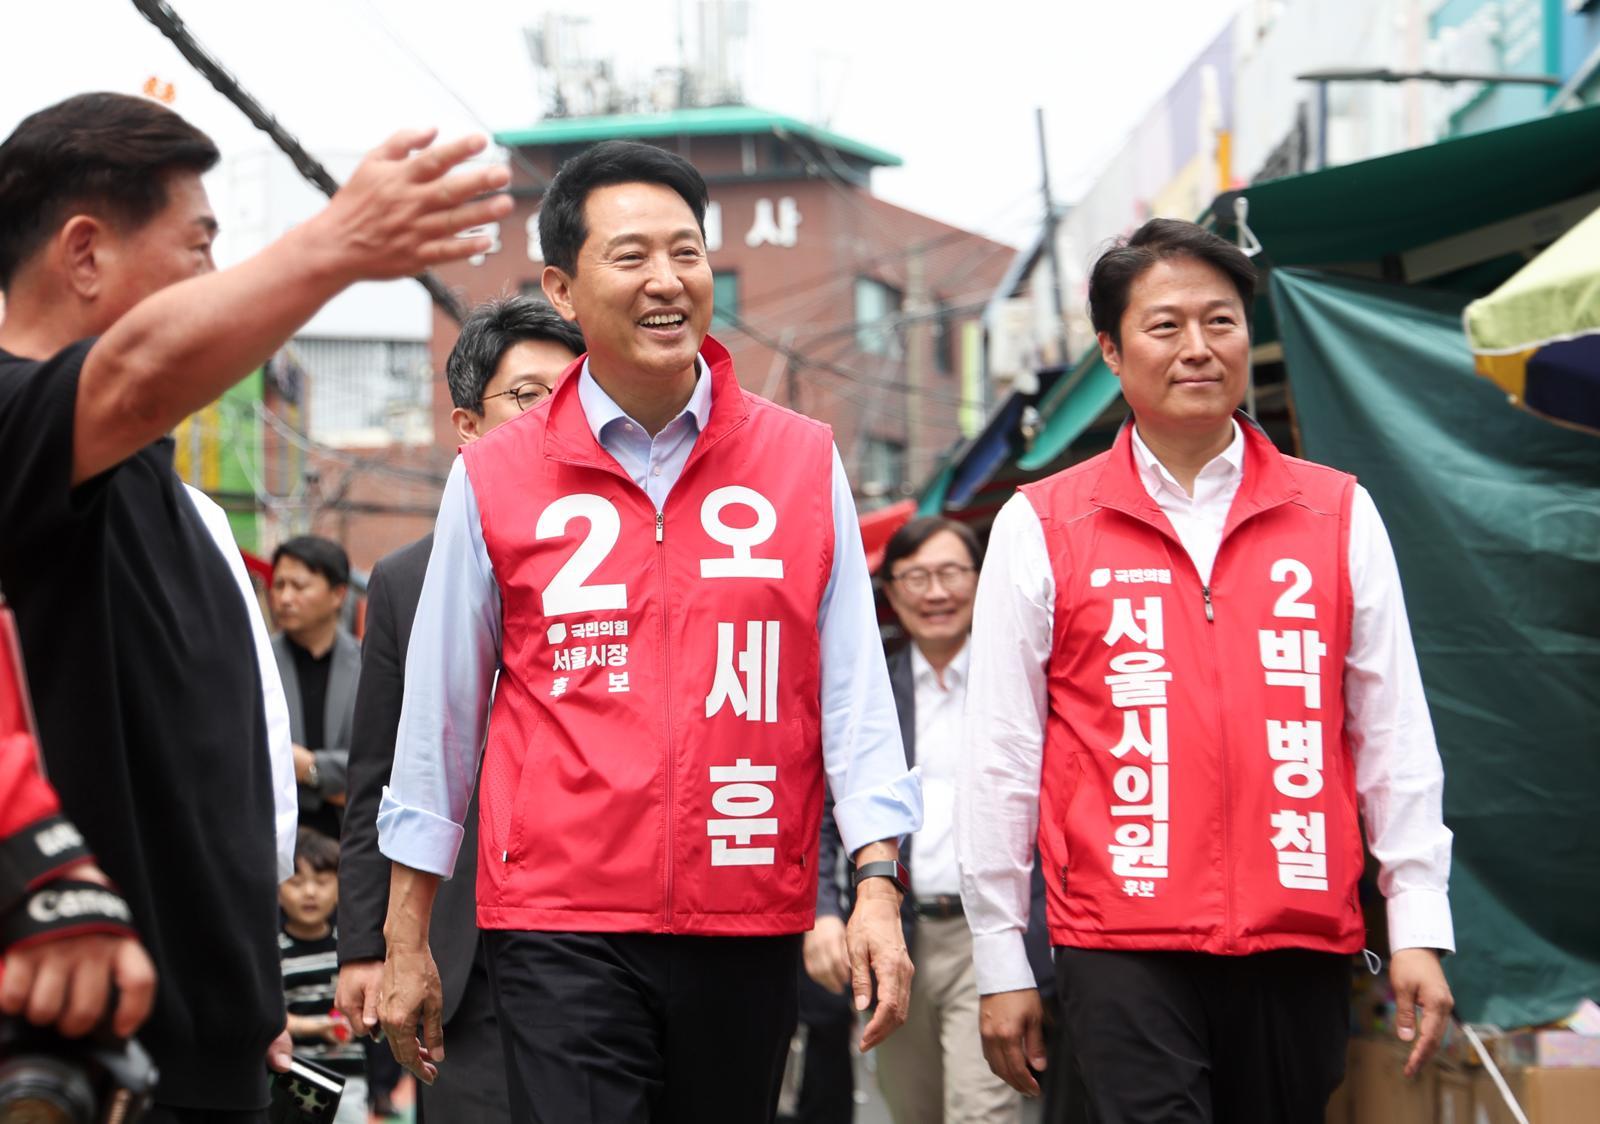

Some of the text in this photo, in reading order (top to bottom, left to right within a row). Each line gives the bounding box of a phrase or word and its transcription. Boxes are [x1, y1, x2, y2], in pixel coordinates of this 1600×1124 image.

[535, 493, 627, 617] 2
[1114, 568, 1172, 585] 국민의힘
[552, 643, 629, 671] 서울시장
[571, 620, 629, 638] 국민의힘
[700, 485, 784, 867] 오세훈
[1102, 596, 1172, 879] 서울시의원
[1258, 558, 1329, 892] 2 박병철
[1122, 879, 1155, 898] 후보
